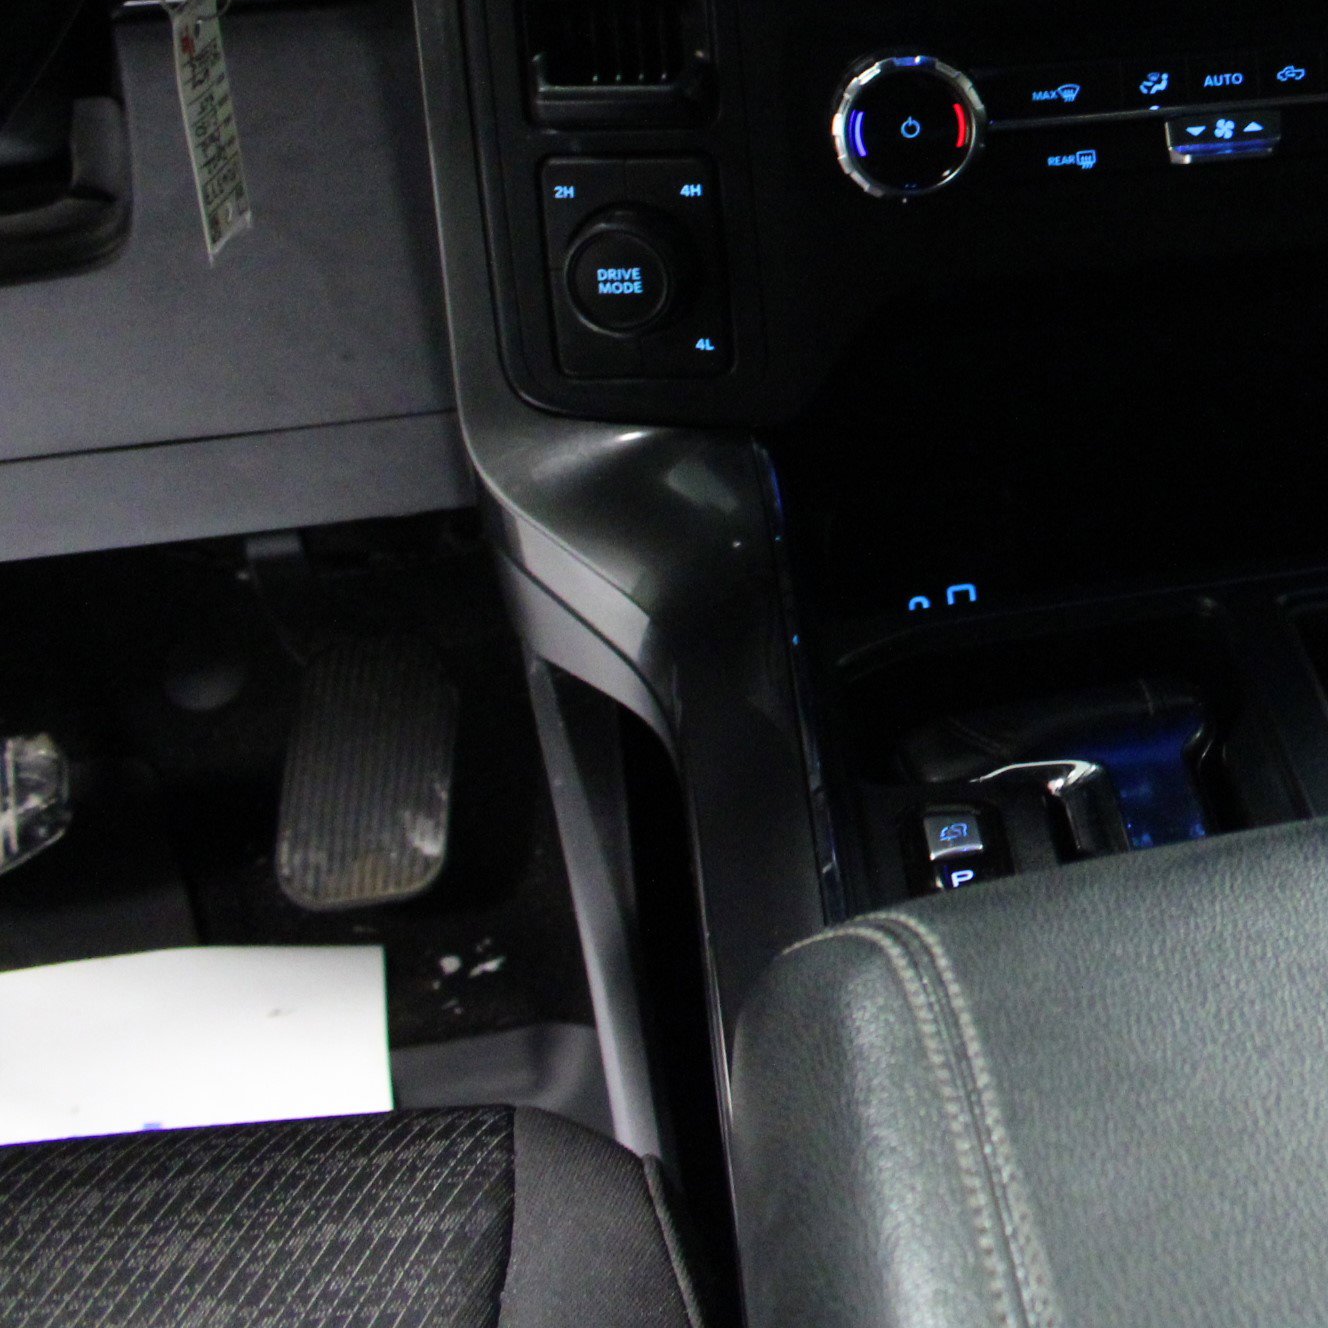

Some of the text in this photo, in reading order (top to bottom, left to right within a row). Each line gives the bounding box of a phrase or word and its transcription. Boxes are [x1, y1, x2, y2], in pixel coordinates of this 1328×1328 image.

[1203, 72, 1243, 88] AUTO
[1032, 90, 1058, 102] MAX
[1047, 154, 1076, 167] REAR
[553, 185, 576, 199] 2H
[680, 184, 703, 198] 4H
[596, 267, 641, 282] DRIVE
[598, 281, 644, 295] MODE
[695, 338, 715, 351] 4L
[951, 869, 975, 888] P
